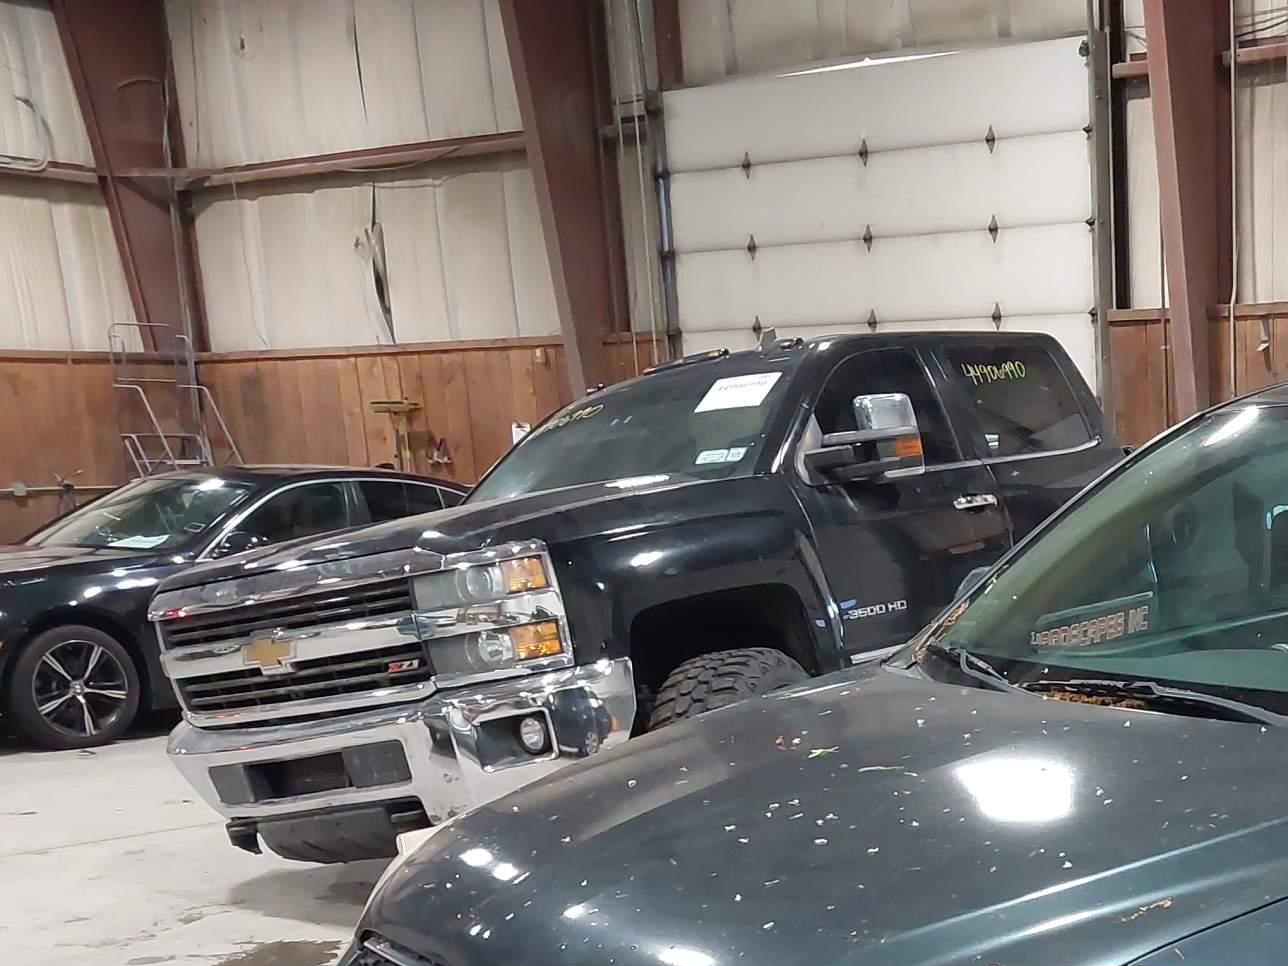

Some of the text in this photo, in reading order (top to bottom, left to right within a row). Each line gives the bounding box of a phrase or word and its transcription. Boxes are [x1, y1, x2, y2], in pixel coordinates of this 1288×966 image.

[960, 360, 1026, 386] 44906990
[846, 604, 886, 620] 3500
[887, 600, 908, 612] HD
